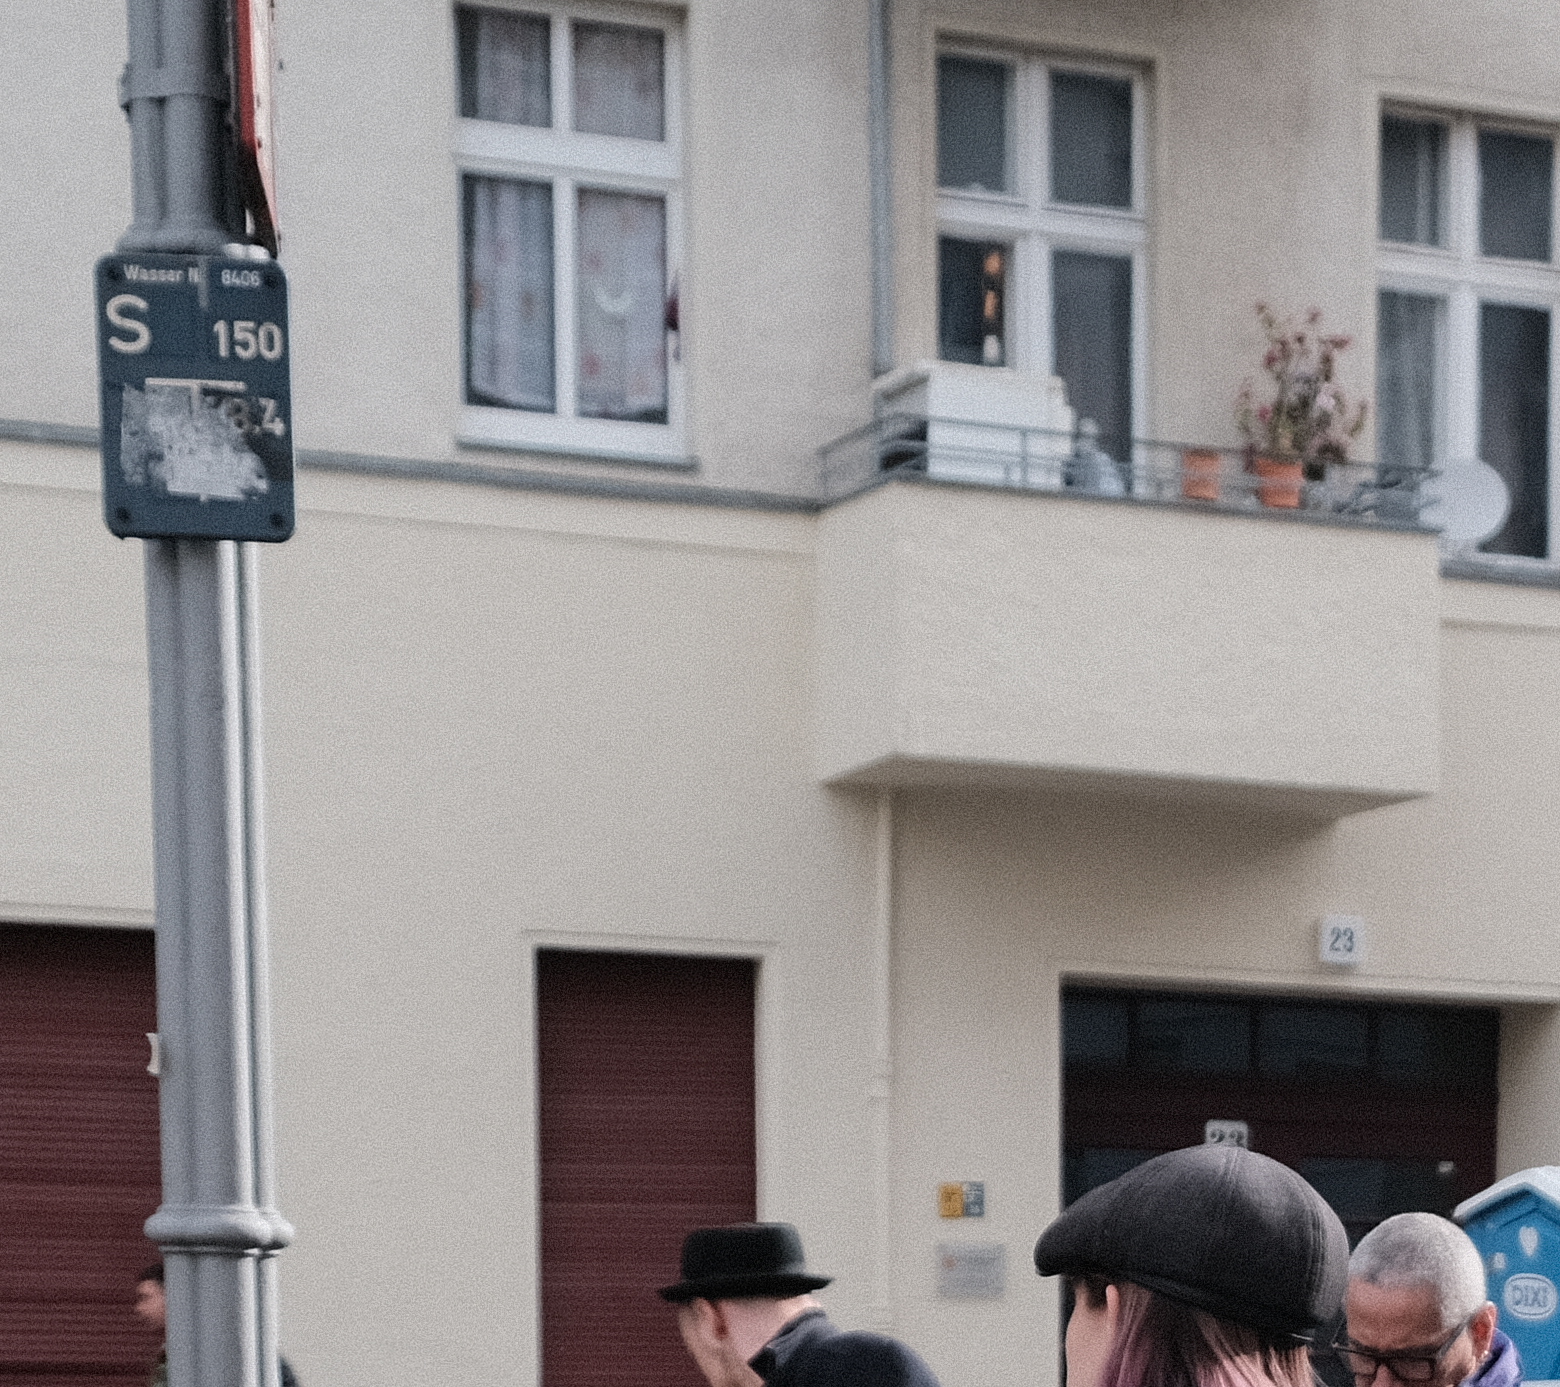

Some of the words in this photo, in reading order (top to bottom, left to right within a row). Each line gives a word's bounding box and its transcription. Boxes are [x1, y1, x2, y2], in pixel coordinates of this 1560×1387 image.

[123, 264, 184, 282] Wasser
[106, 294, 151, 353] S
[213, 320, 284, 361] 150
[1329, 926, 1354, 953] 23
[1512, 1284, 1549, 1308] DIXI
